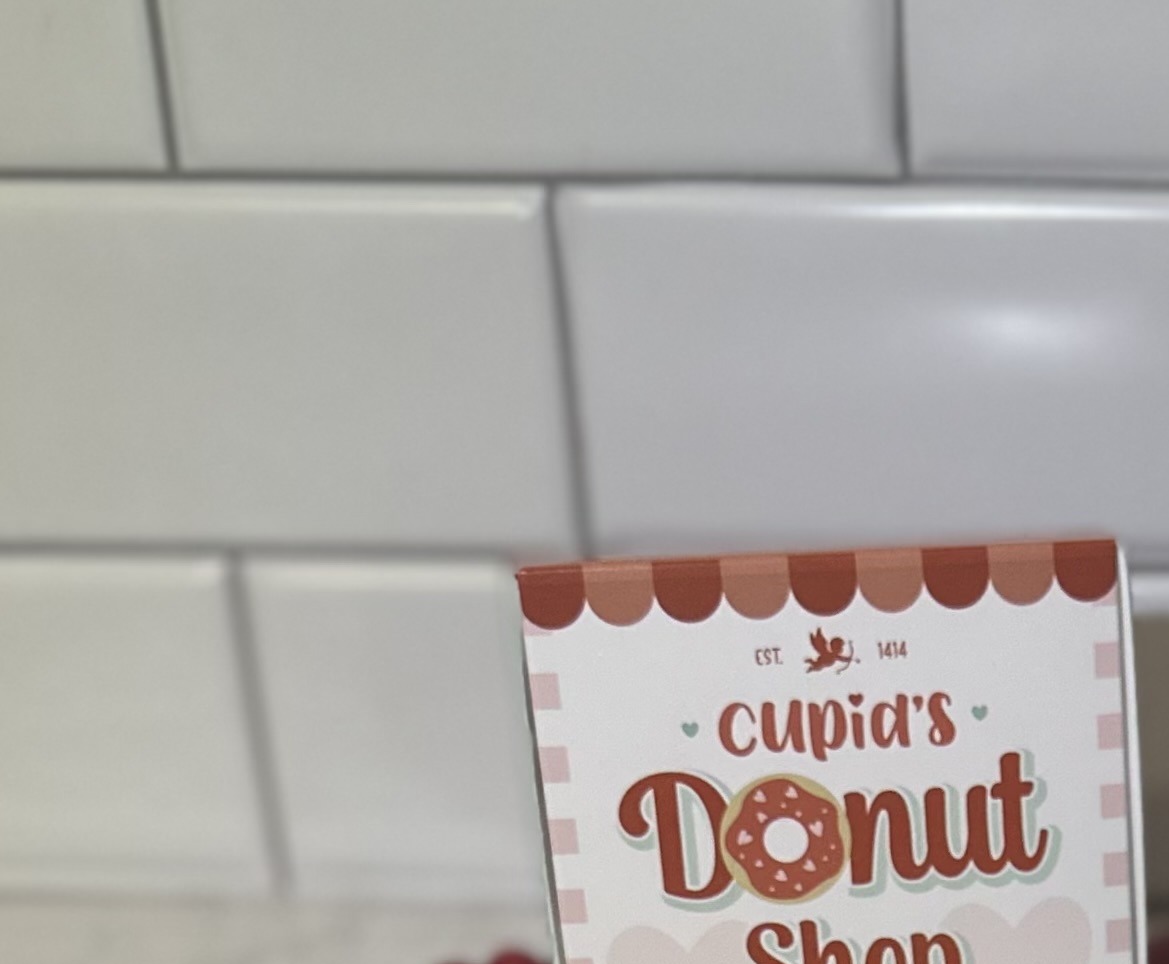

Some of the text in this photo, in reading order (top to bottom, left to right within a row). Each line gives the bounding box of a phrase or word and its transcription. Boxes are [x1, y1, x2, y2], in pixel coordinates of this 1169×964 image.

[754, 641, 907, 665] EST. 1414
[618, 752, 1052, 906] Donut
